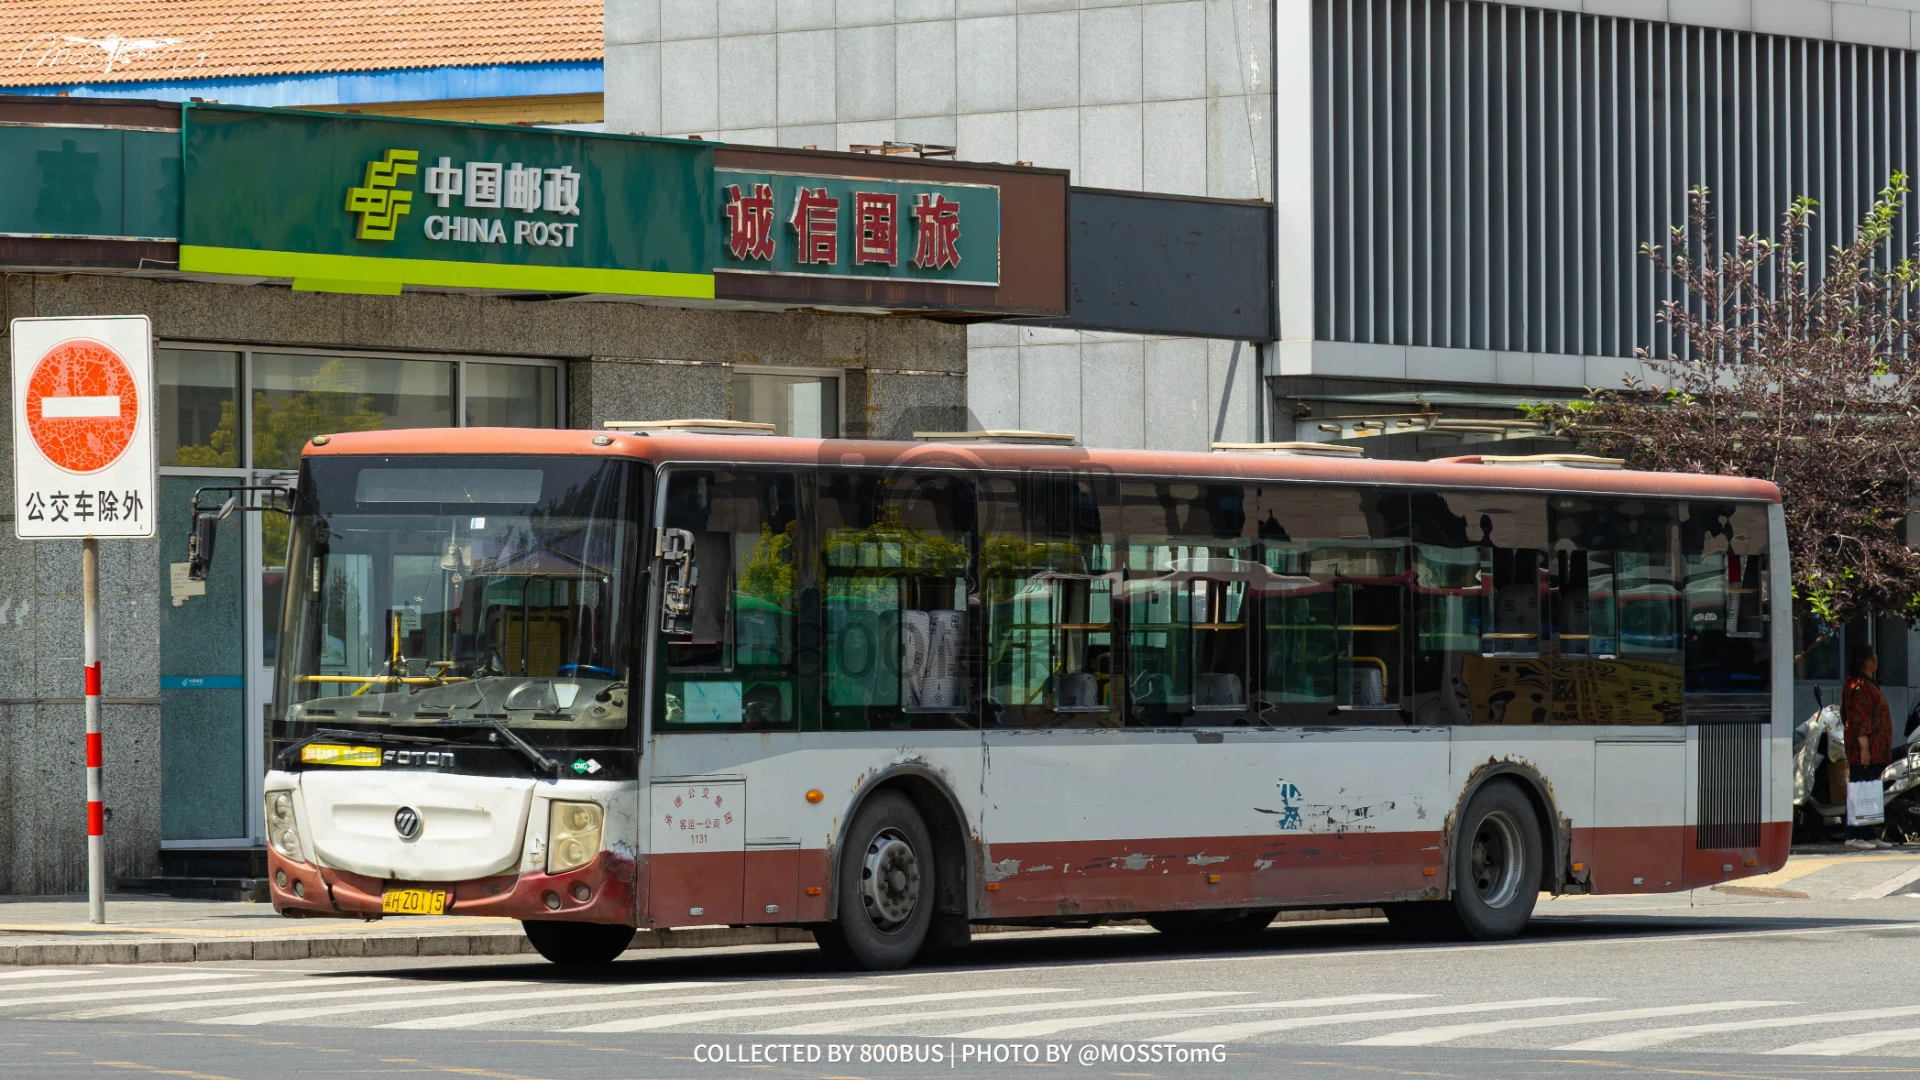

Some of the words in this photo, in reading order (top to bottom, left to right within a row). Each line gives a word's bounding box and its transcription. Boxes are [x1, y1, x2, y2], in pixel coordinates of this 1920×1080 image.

[424, 156, 581, 216] 中国邮政
[424, 215, 508, 244] CHINA
[513, 220, 579, 248] POST
[723, 182, 962, 270] 诚信国旅
[25, 489, 144, 523] 公交车除外
[382, 749, 455, 767] FOTON
[574, 762, 588, 770] CNG
[679, 818, 720, 830] 客运一公司
[690, 833, 708, 844] 1131
